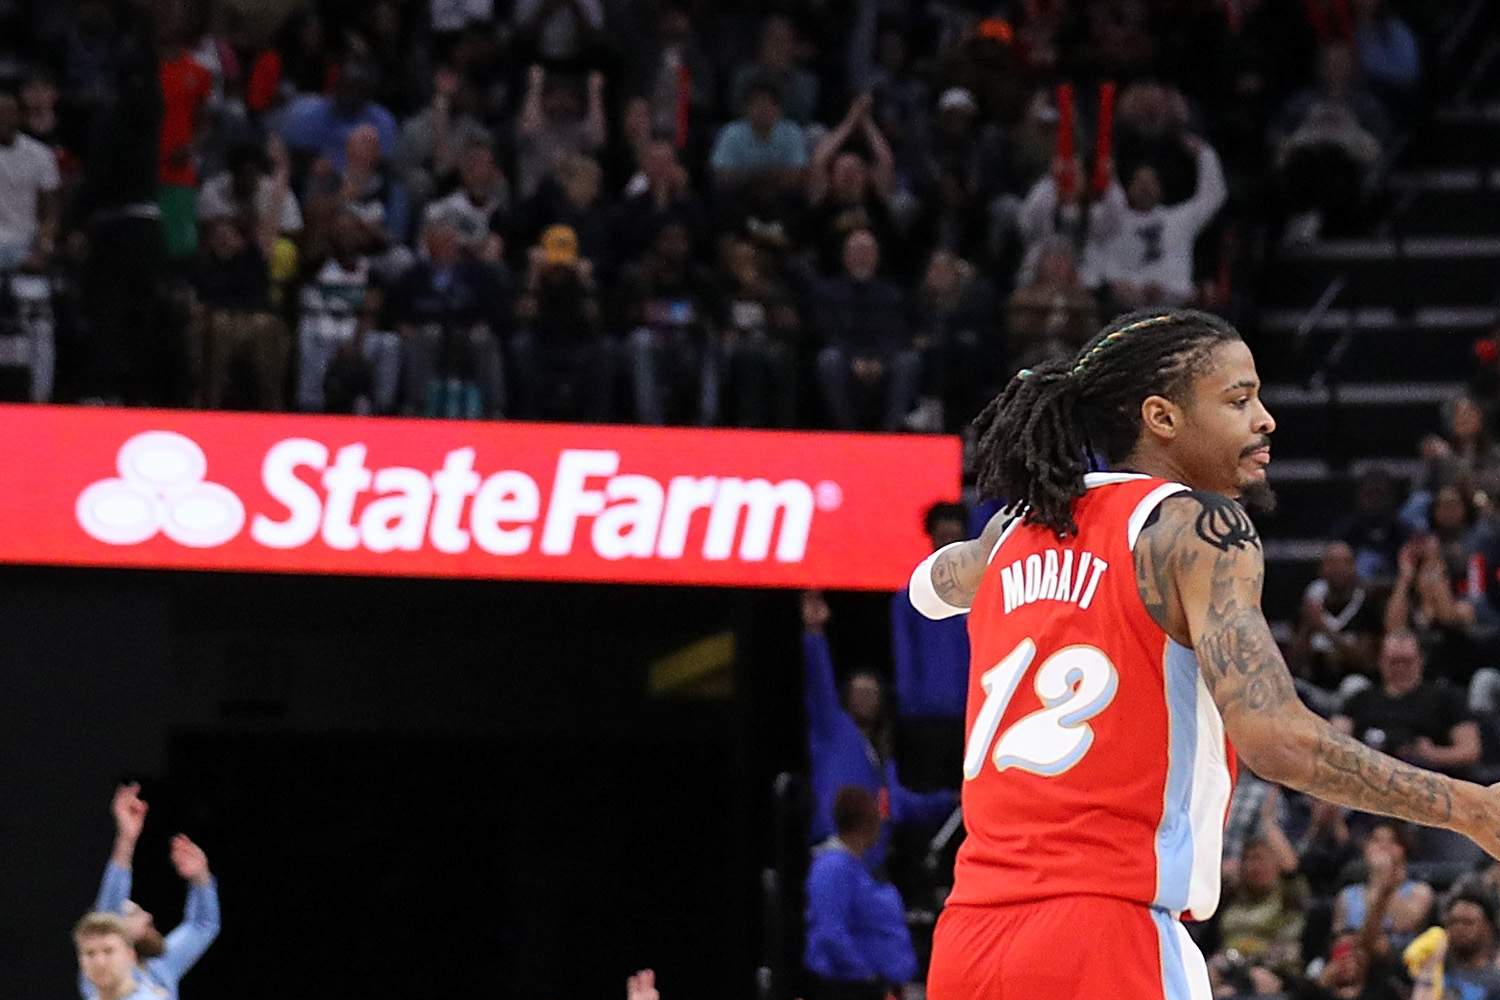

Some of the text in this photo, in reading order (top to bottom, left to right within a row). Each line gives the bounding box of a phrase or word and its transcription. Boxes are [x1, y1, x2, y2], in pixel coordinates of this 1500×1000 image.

[251, 437, 816, 563] State Farm
[962, 637, 1120, 782] 12
